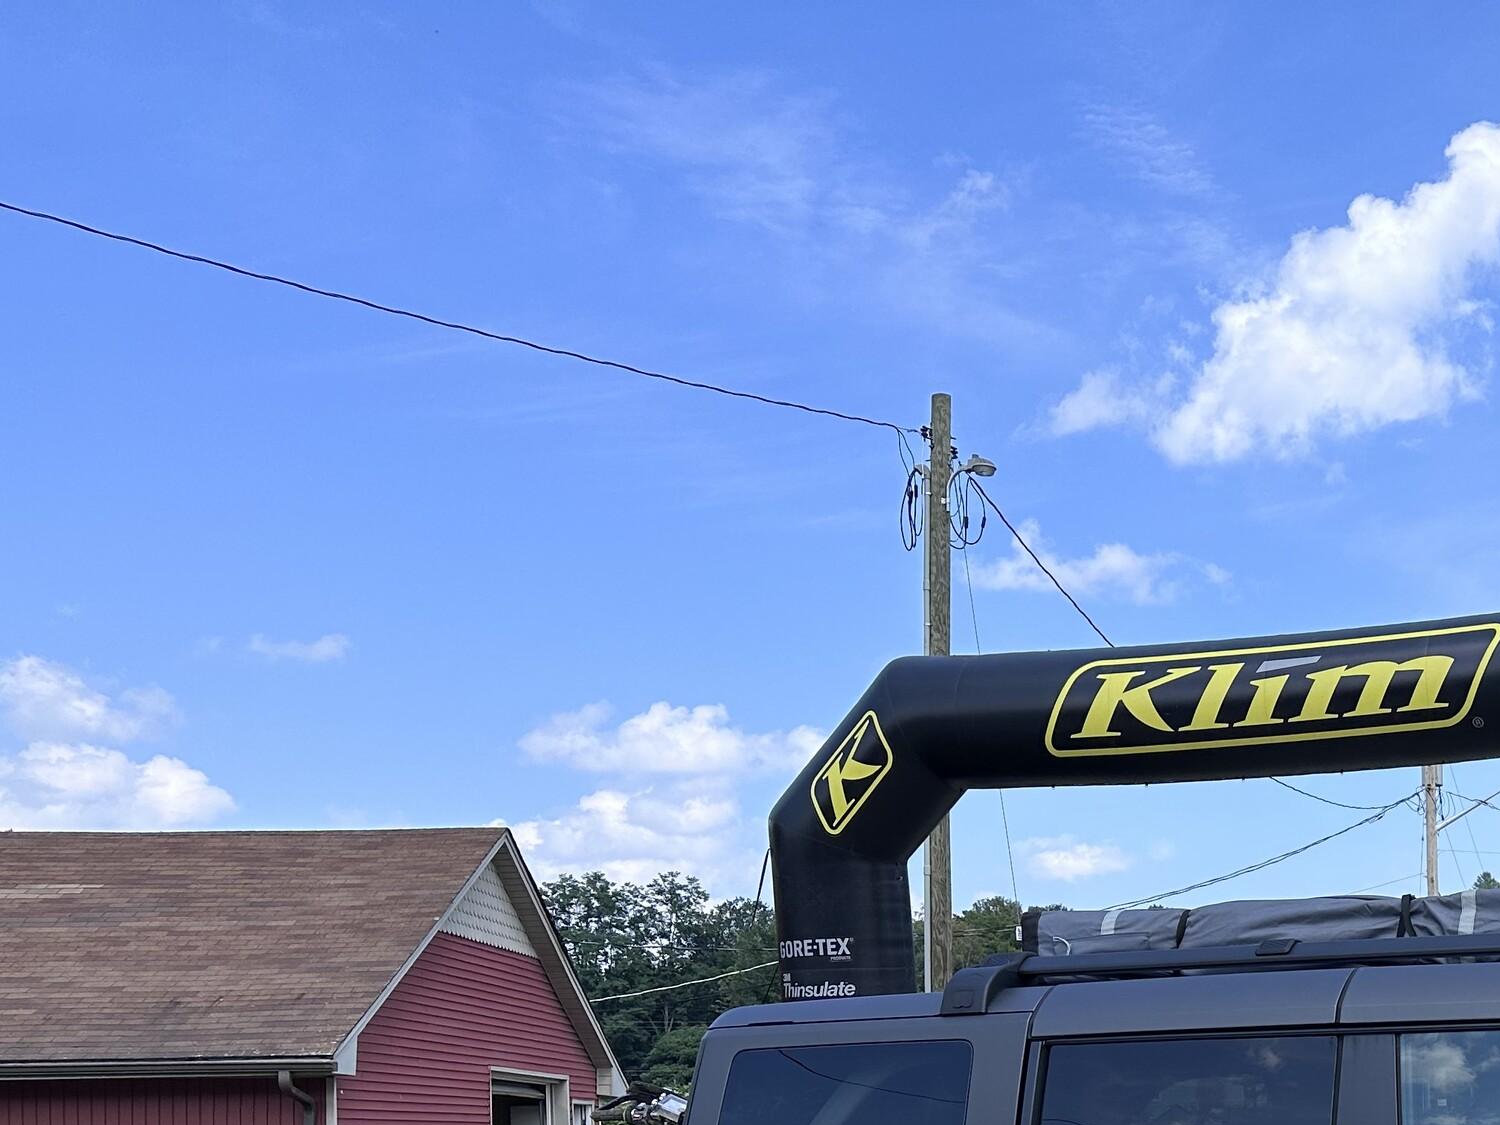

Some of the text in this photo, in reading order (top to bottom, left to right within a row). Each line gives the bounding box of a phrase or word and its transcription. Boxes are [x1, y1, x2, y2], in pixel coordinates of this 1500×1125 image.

[822, 719, 882, 827] K
[780, 938, 851, 959] GORE-TEX
[783, 981, 856, 998] Thinsulate
